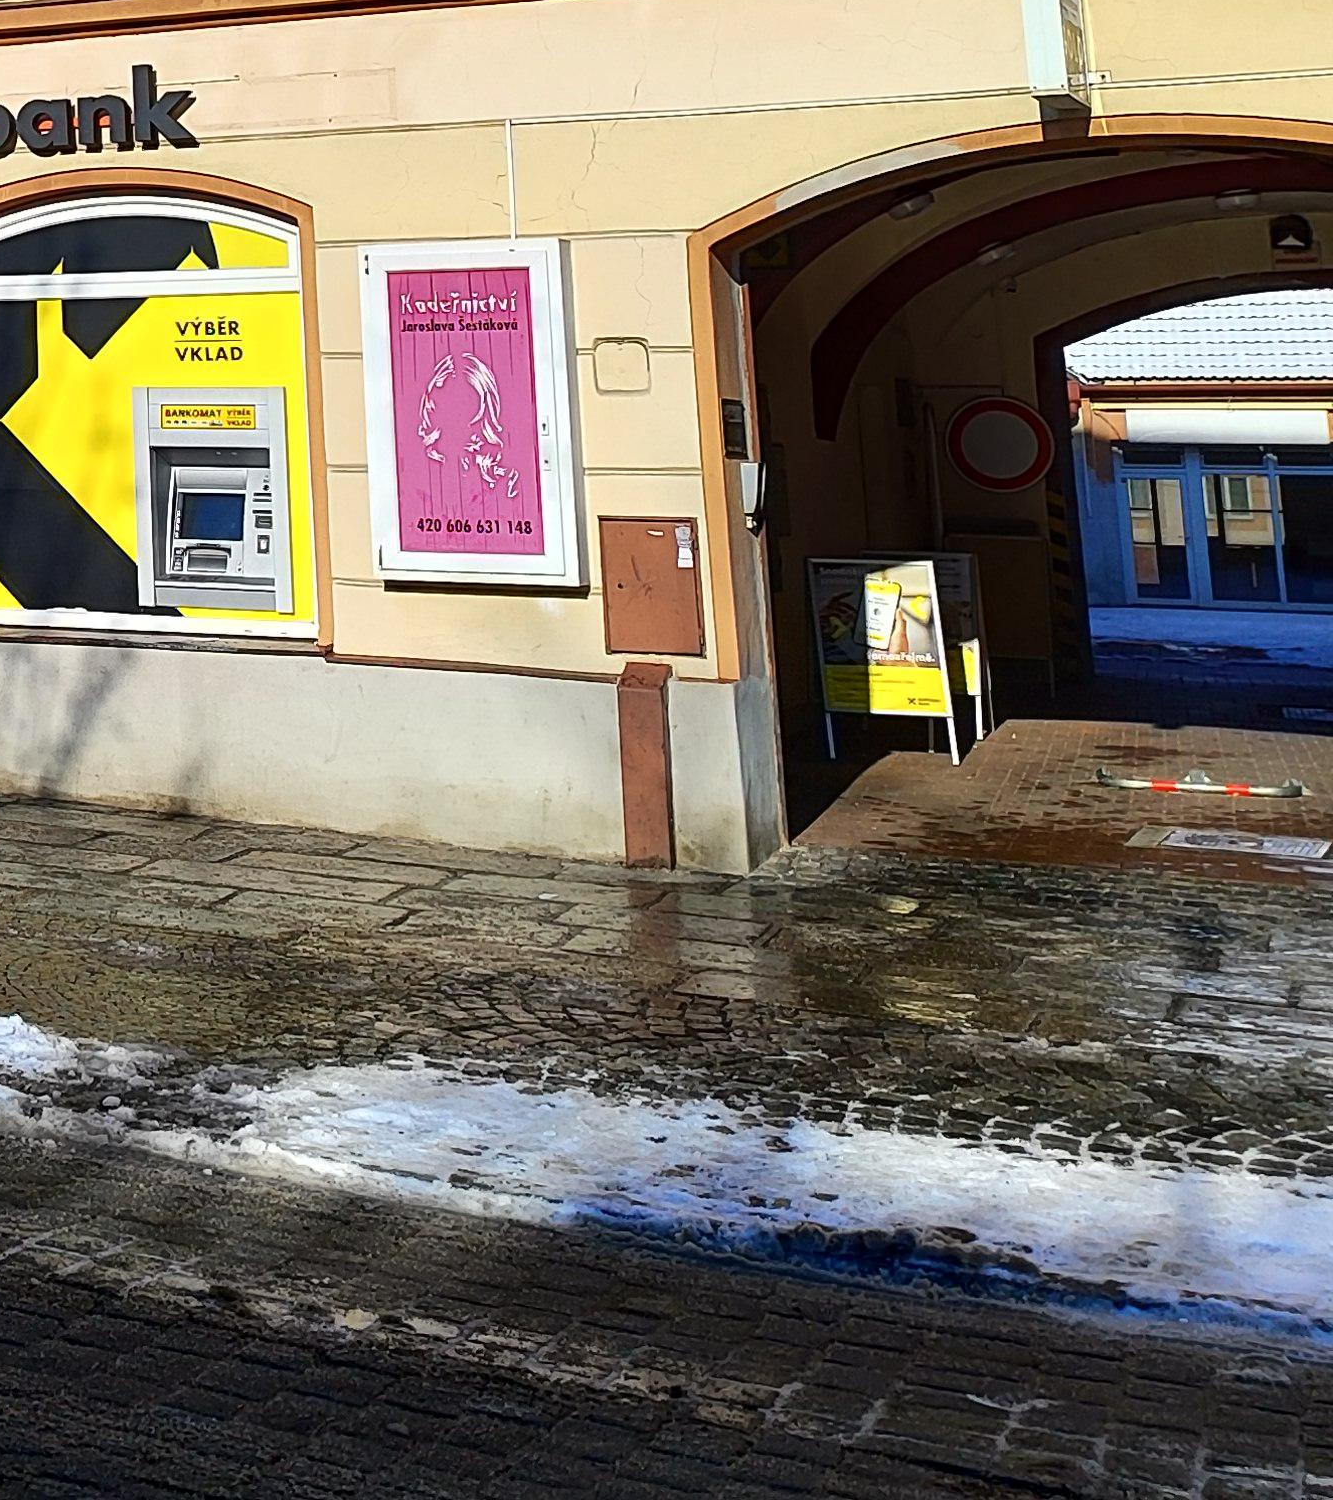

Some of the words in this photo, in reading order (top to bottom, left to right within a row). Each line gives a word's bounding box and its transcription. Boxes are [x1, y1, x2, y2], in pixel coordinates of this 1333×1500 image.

[175, 315, 240, 336] VÝBĚR
[401, 319, 455, 333] Jaroslava
[458, 316, 519, 331] Šestáková
[174, 346, 243, 361] VKLAD
[165, 409, 222, 418] BANKOMAT
[417, 518, 442, 532] 420
[446, 519, 472, 533] 606
[476, 520, 500, 534] 631
[507, 520, 533, 535] 148
